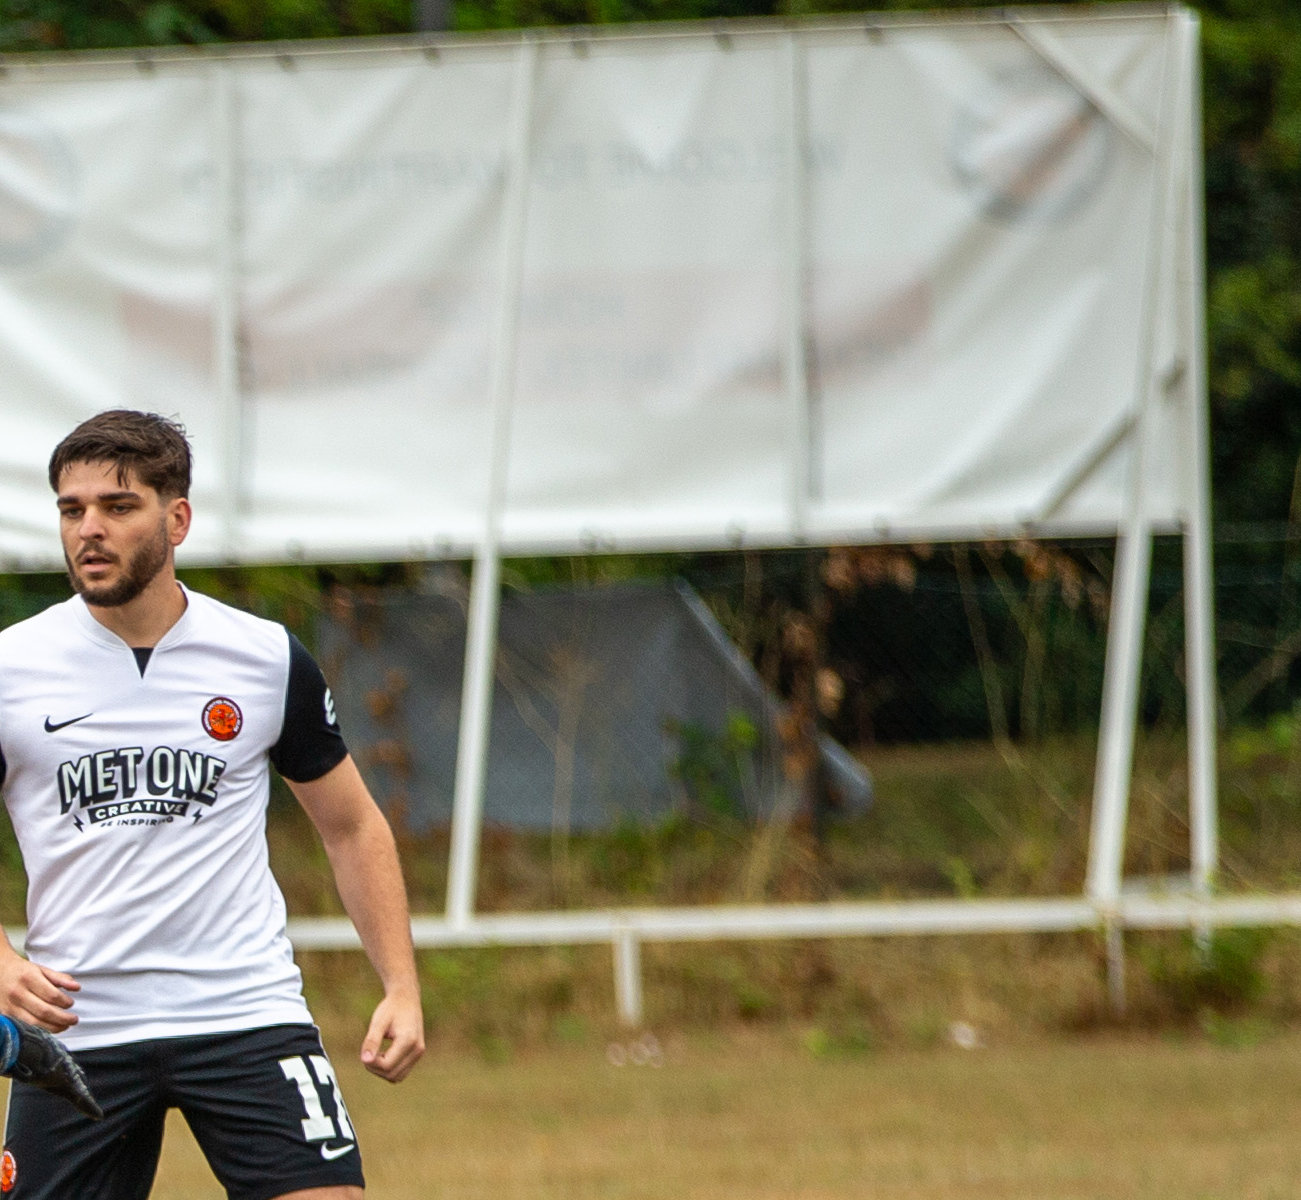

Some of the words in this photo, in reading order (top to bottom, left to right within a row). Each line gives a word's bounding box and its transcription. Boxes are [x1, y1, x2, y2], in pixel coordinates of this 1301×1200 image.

[57, 747, 144, 815] MET
[147, 746, 227, 806] ONE
[95, 800, 184, 820] CREATIVE
[278, 1055, 355, 1142] 17
